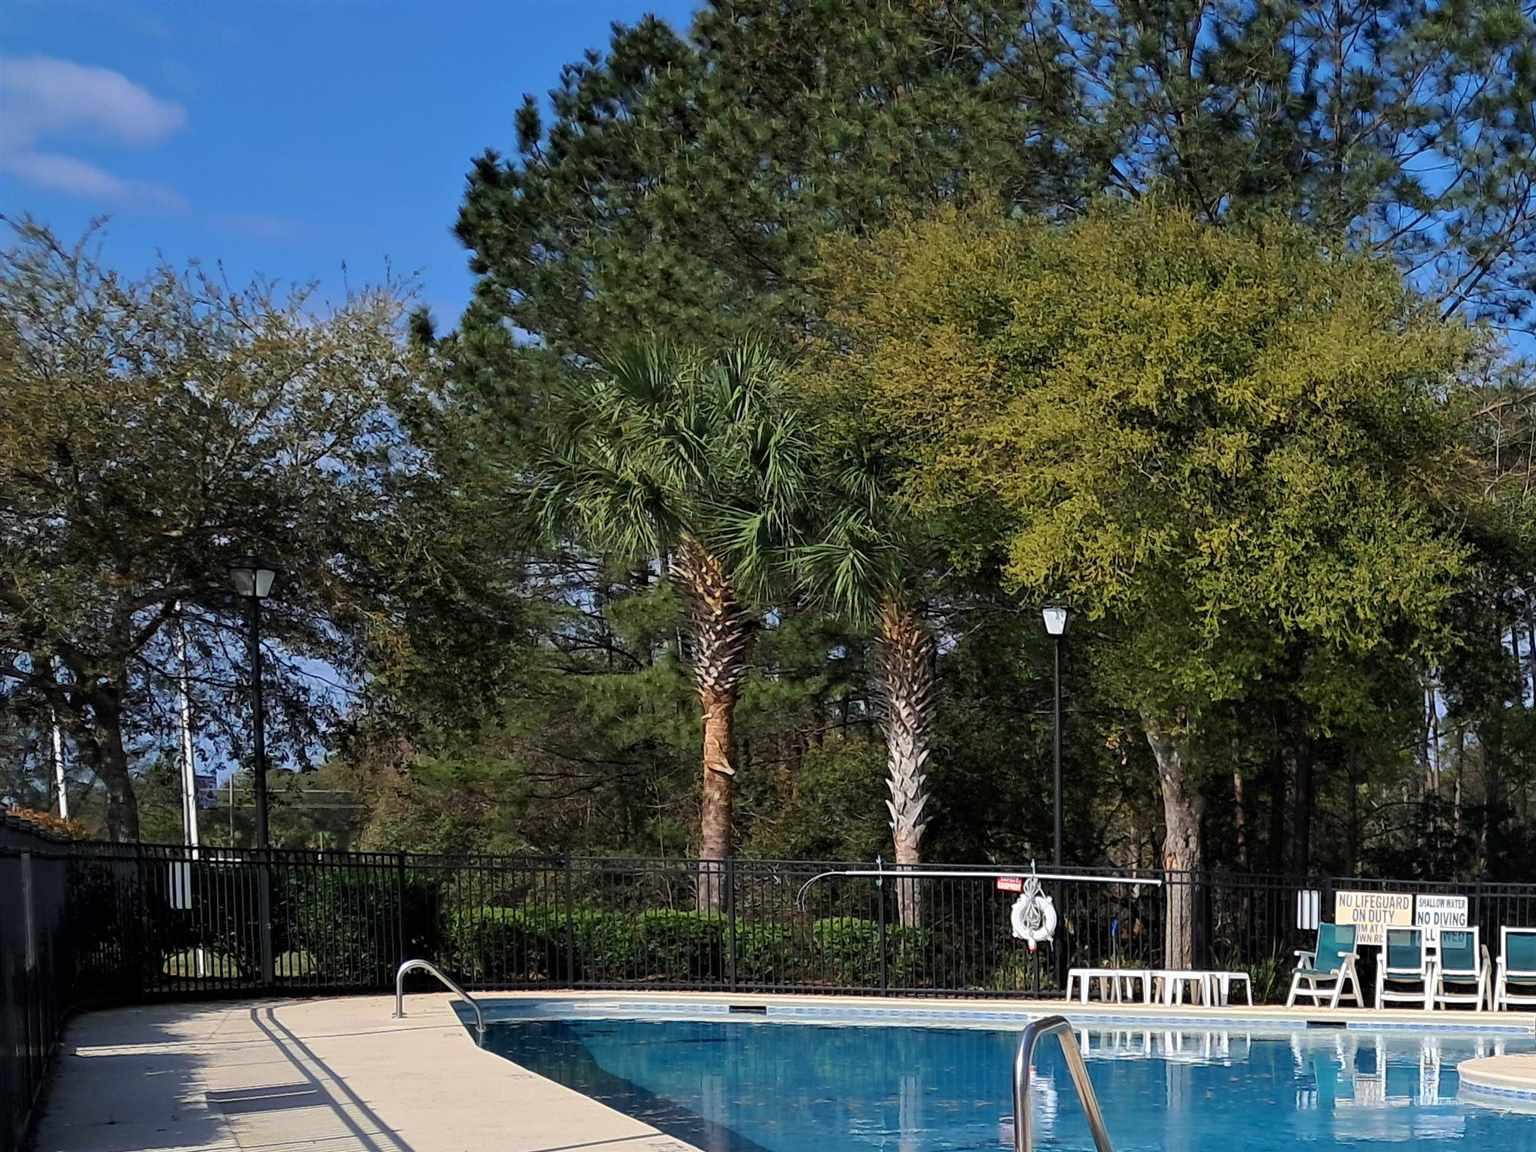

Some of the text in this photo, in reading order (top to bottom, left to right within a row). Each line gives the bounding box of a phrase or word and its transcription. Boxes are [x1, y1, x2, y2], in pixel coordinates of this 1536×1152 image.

[1339, 894, 1409, 910] NO LIFEGUARD
[1419, 897, 1466, 909] SHALLOW WATER
[1352, 909, 1395, 924] ON DUTY
[1417, 911, 1466, 926] NO DIVING
